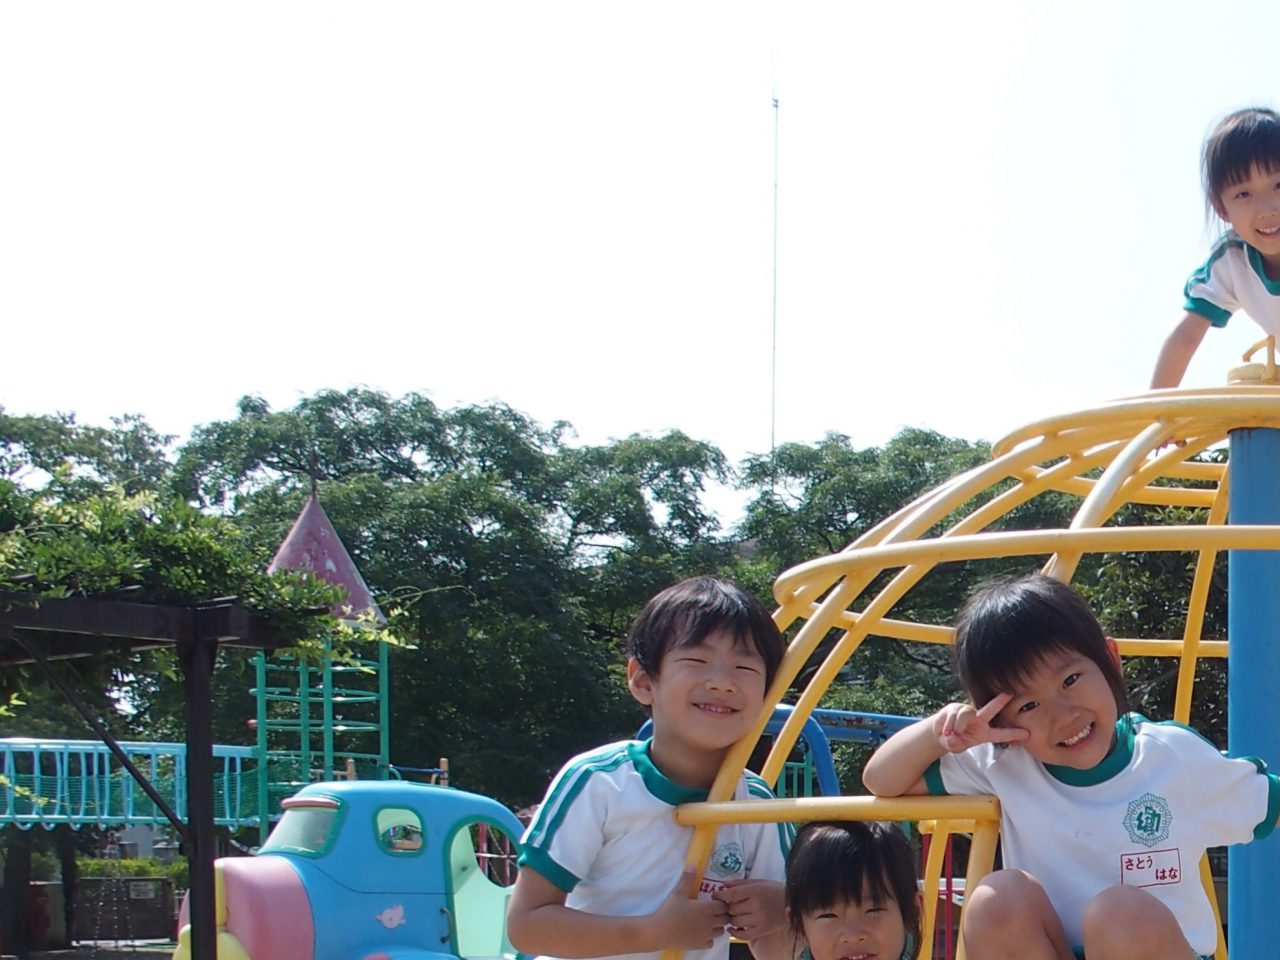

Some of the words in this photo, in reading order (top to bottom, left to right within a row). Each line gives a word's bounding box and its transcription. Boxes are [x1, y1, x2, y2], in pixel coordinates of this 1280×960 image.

[1124, 855, 1153, 871] さとう
[1155, 867, 1178, 880] はな
